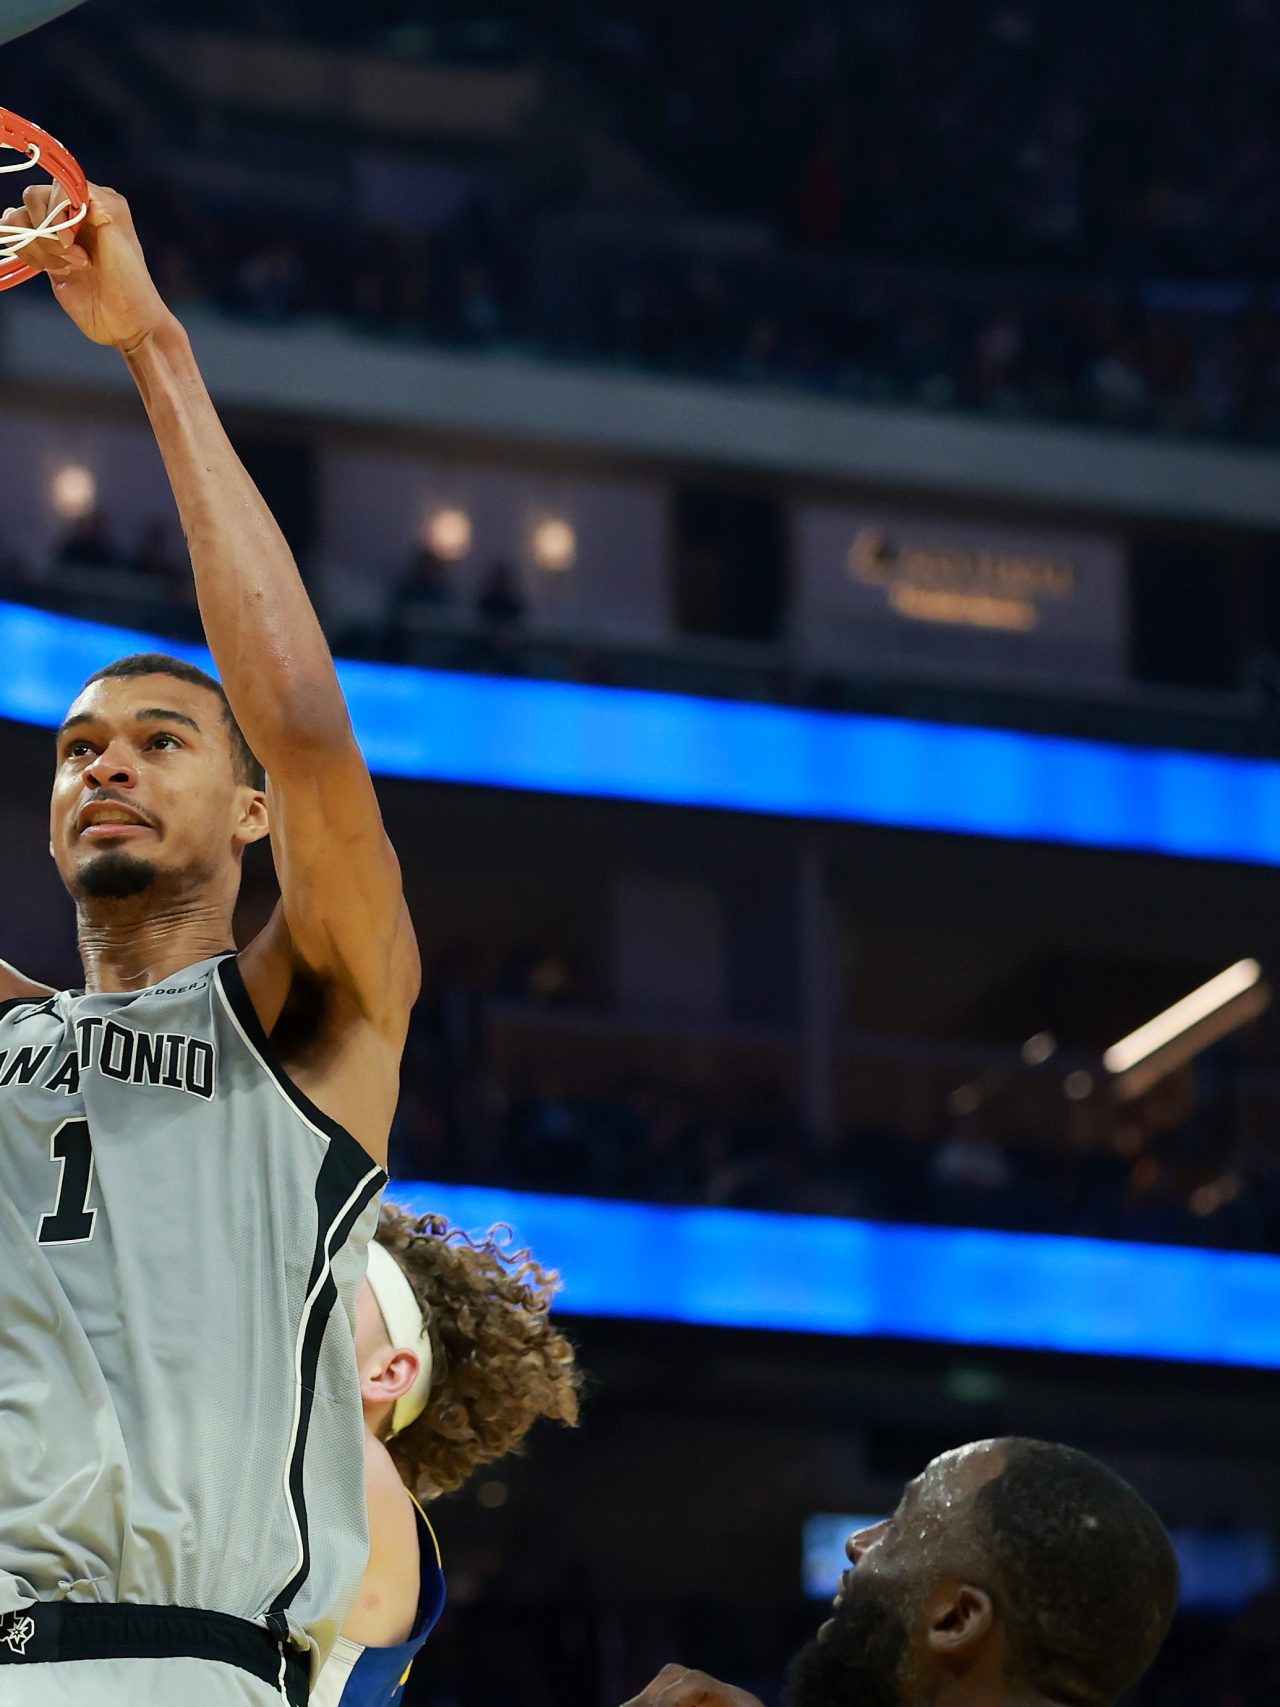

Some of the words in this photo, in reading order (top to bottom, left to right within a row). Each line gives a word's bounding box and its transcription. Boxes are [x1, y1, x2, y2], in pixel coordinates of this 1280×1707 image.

[144, 982, 198, 997] EDGER
[41, 1016, 216, 1101] ATONIO
[36, 1115, 98, 1245] 1
